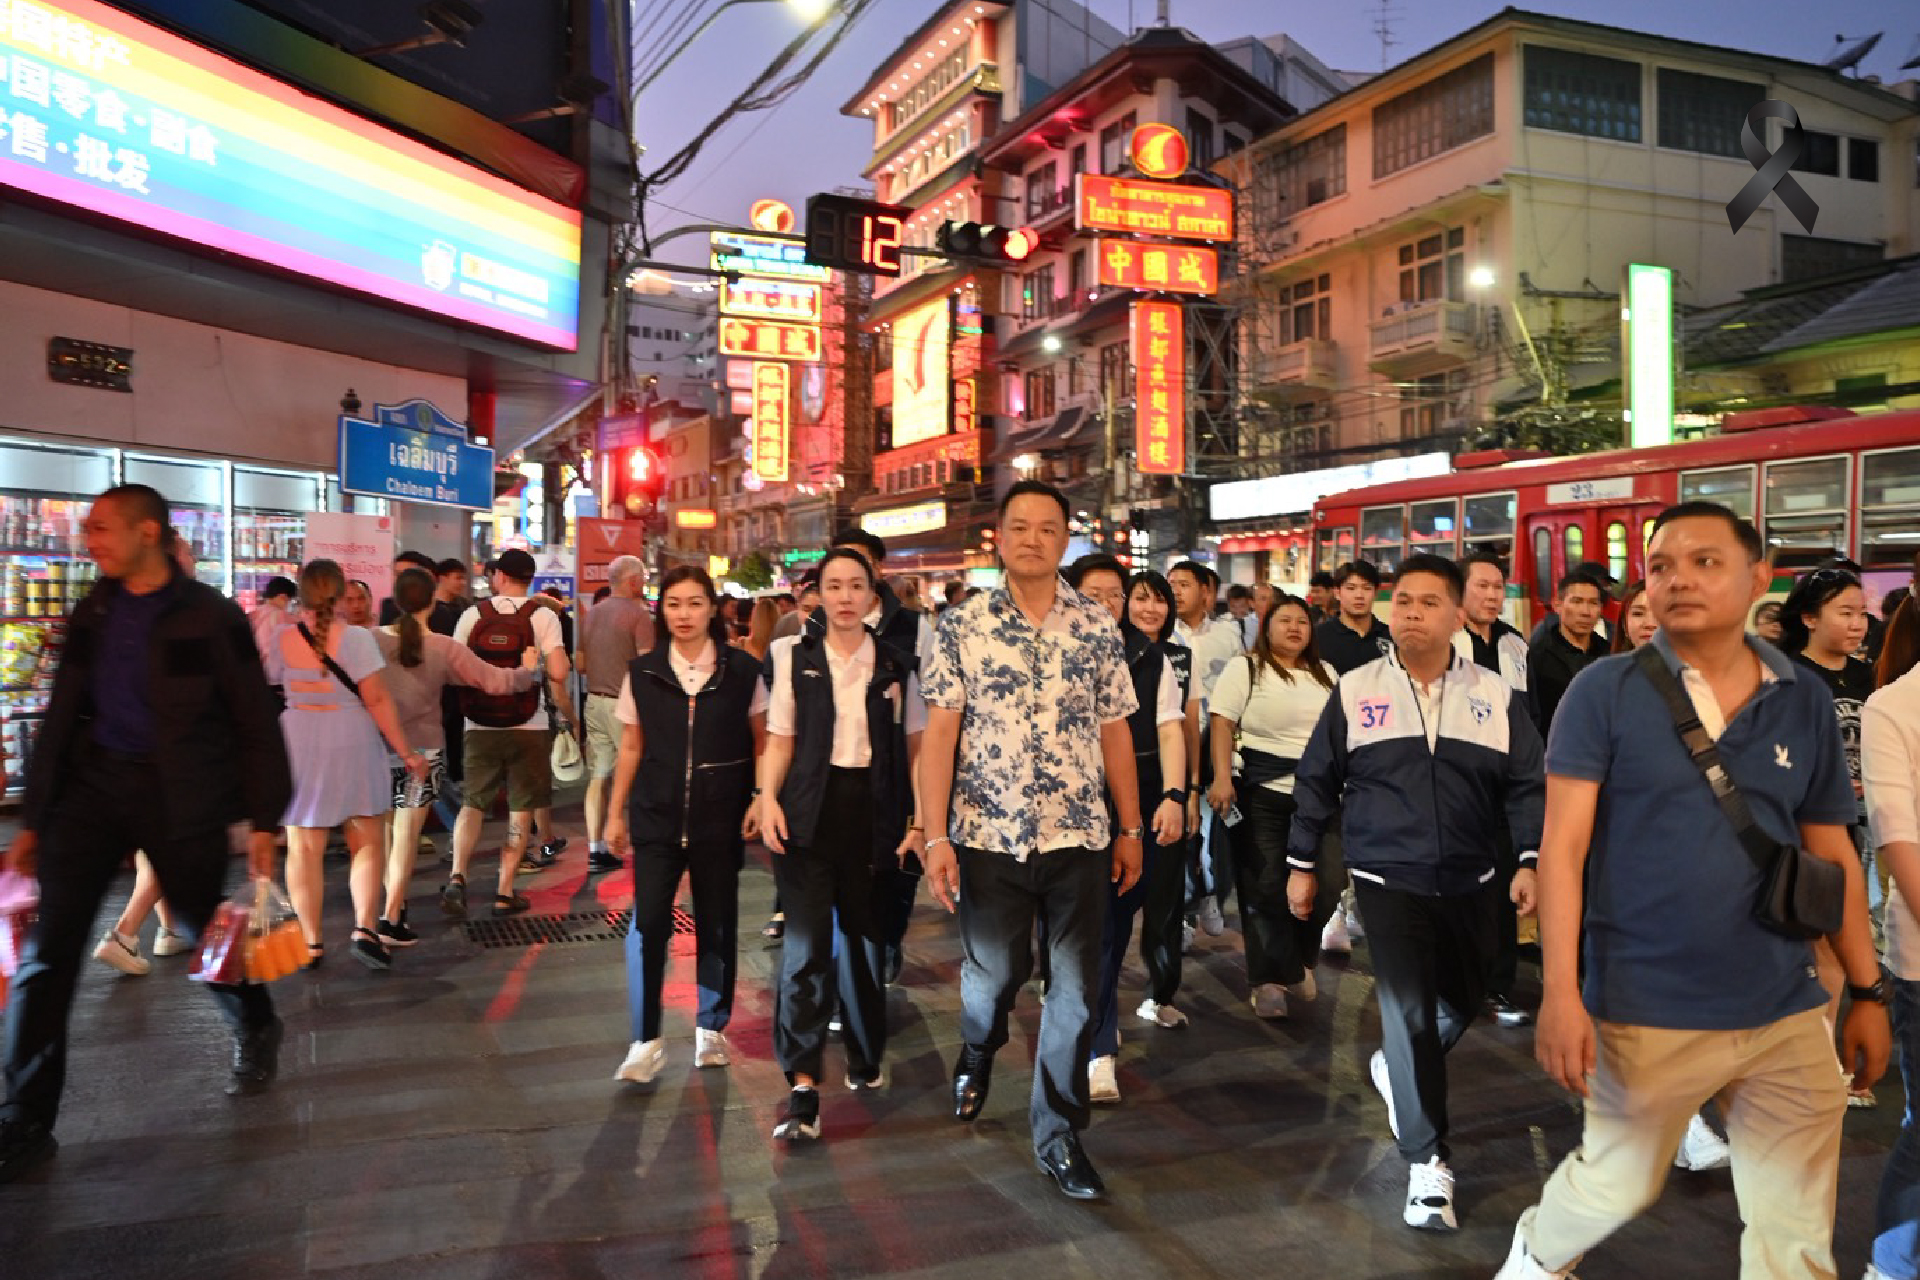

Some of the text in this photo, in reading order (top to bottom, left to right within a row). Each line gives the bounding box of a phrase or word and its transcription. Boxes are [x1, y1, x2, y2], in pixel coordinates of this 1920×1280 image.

[0, 0, 131, 71] 国特产
[0, 54, 219, 167] 国零食·副食
[861, 215, 902, 270] 12
[389, 437, 458, 484] เฉลิมบุรี
[1361, 704, 1390, 729] 37
